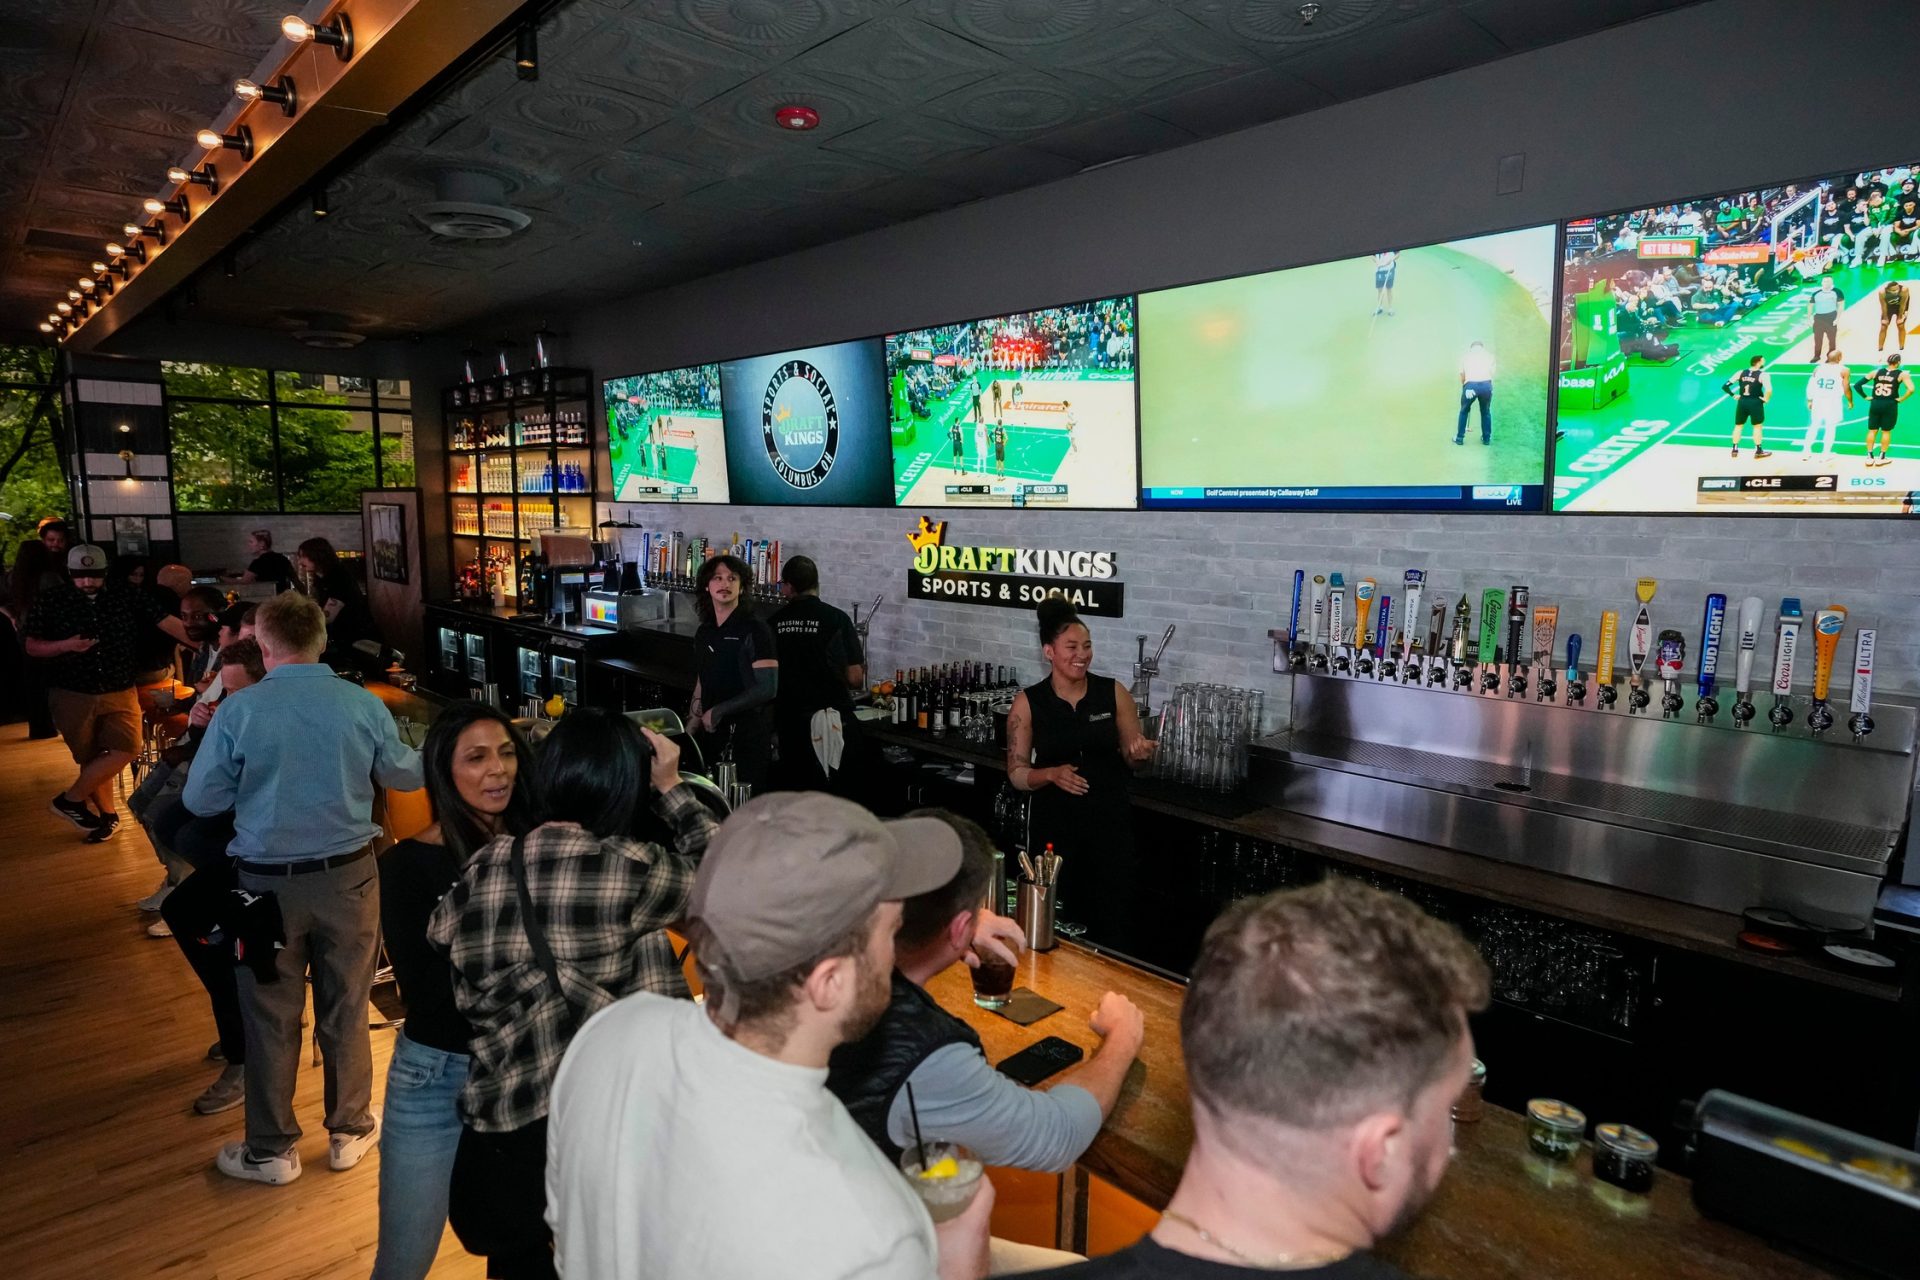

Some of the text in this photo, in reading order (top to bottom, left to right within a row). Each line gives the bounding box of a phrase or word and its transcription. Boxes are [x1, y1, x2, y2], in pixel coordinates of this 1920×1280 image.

[764, 362, 834, 416] SPORTS & SOCIAL
[1816, 377, 1835, 390] 42
[785, 430, 824, 445] KINGS
[1568, 420, 1671, 472] CELTICS
[820, 451, 833, 472] OH
[1239, 489, 1269, 498] presented
[1269, 489, 1277, 498] by
[1277, 489, 1304, 497] Callaway
[1305, 488, 1319, 496] Golf
[1815, 476, 1833, 488] 2
[1851, 477, 1886, 486] BOS
[913, 543, 1116, 579] DRAFTKINGS
[921, 577, 991, 598] SPORTS
[999, 583, 1011, 600] &
[1484, 599, 1502, 635] Garage
[1603, 632, 1612, 653] WHEAT
[1704, 608, 1724, 674] BUD LIGHT
[1741, 631, 1755, 651] lite
[1601, 653, 1611, 676] MANGO
[1776, 637, 1793, 690] Coors LIGHT
[1856, 631, 1873, 711] Michelob ULTRA
